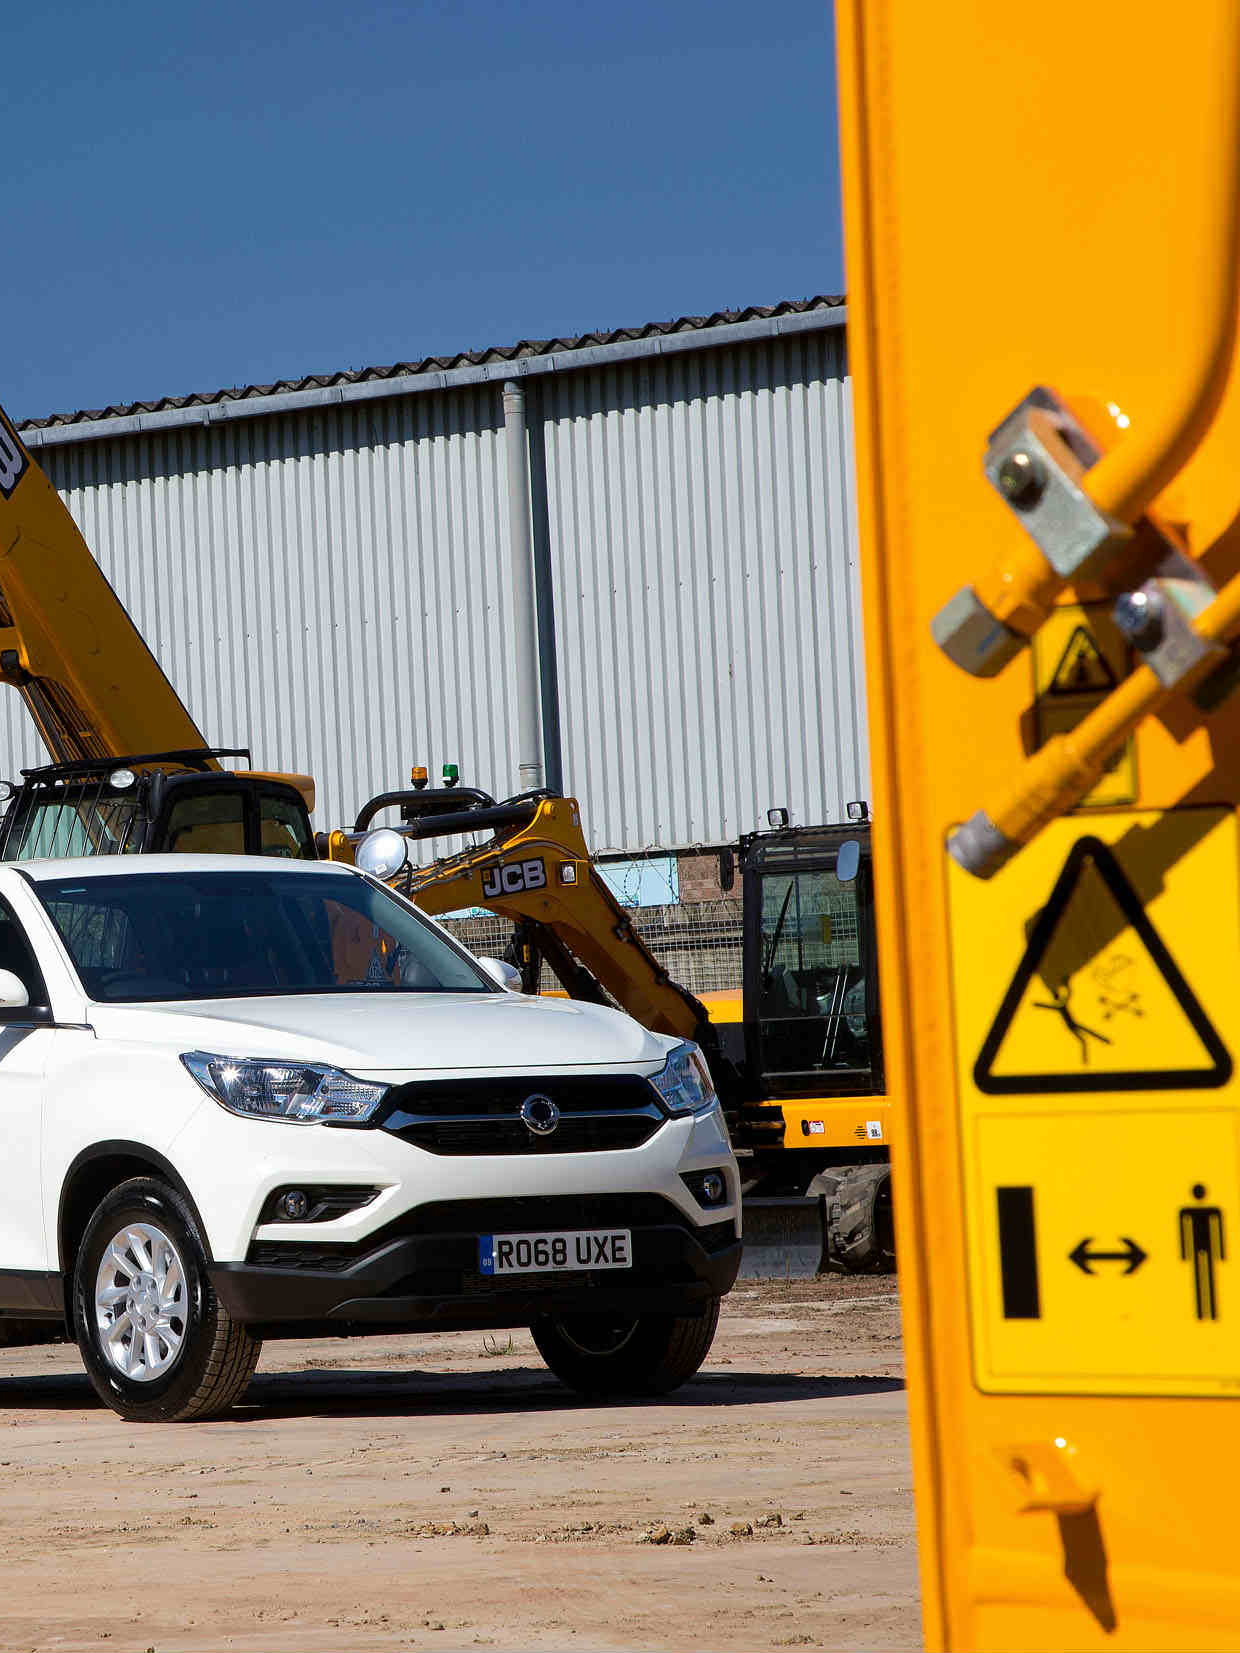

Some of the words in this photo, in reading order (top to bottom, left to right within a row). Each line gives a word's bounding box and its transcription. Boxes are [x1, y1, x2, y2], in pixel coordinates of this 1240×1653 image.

[484, 860, 546, 897] JCB
[497, 1238, 568, 1268] RO68
[576, 1235, 627, 1264] UXE
